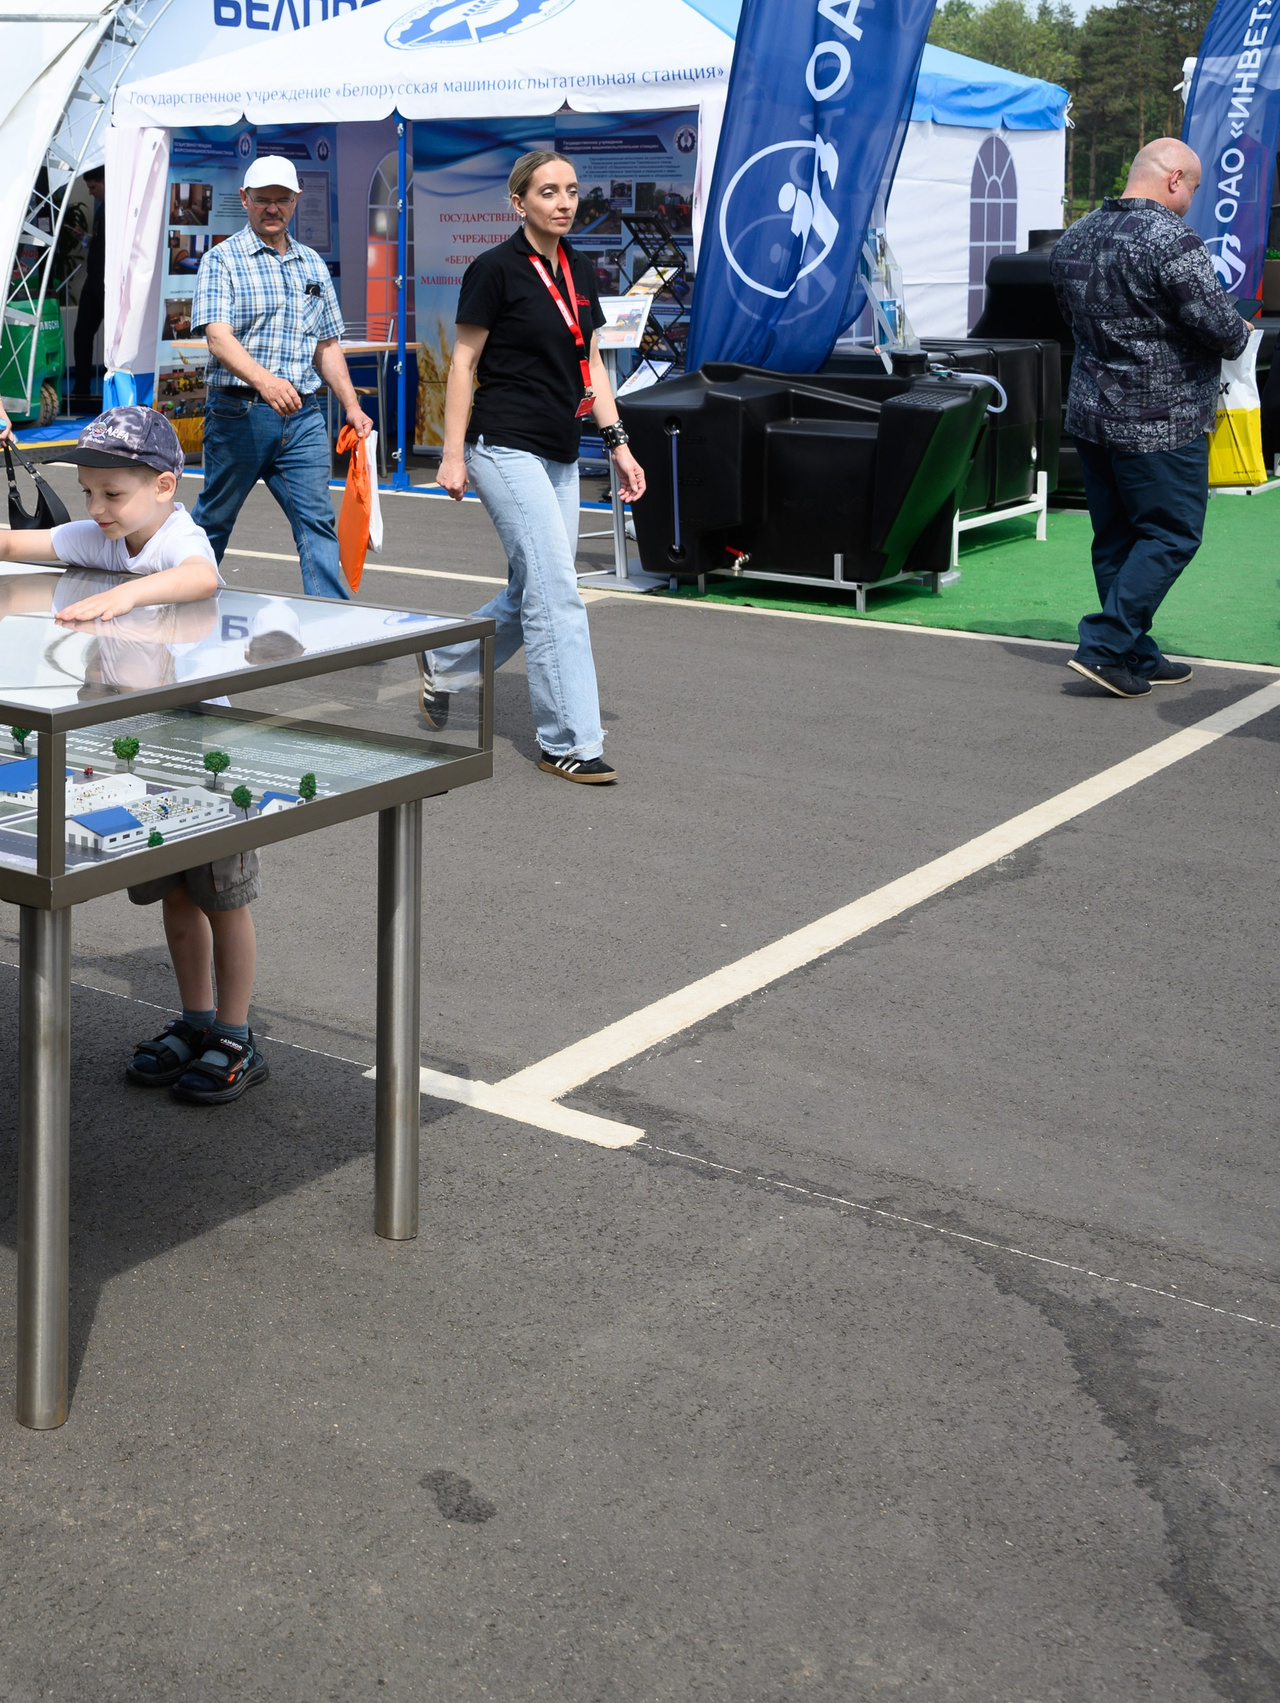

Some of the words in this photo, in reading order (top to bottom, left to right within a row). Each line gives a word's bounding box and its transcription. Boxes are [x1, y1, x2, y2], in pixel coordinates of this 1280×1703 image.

[130, 91, 242, 107] Государственное
[246, 87, 331, 105] учреждение
[336, 81, 438, 99] «Белорусская
[443, 70, 636, 93] машиноиспытательная
[642, 66, 724, 83] станция»
[1215, 148, 1245, 223] ОАО
[440, 213, 522, 223] ГОСУДАРСТВЕНН
[452, 234, 511, 244] УЧРЕЖДЕН
